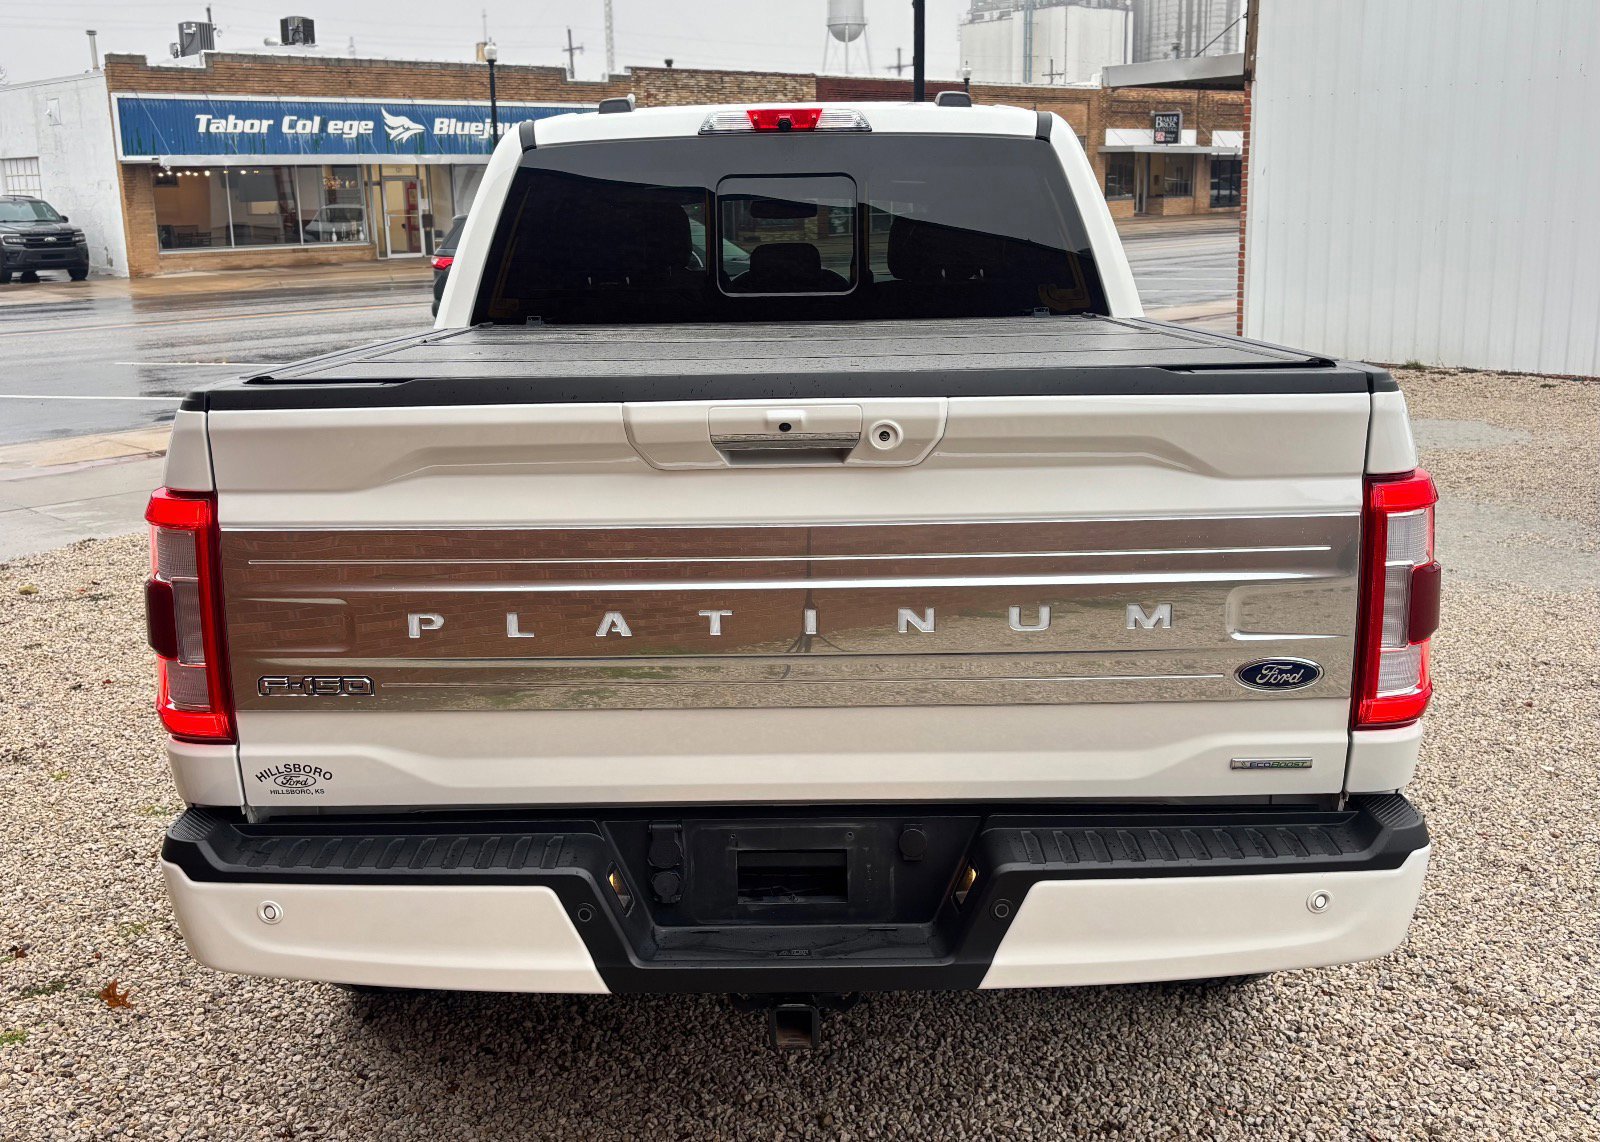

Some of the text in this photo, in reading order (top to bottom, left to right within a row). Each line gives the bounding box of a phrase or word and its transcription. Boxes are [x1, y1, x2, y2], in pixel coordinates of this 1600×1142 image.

[195, 114, 274, 134] Tabor
[407, 602, 1173, 639] PLATINUM
[1255, 664, 1305, 684] Ford
[257, 675, 375, 697] F-150
[255, 763, 333, 783] HILLSBORO
[281, 775, 309, 786] Ford
[269, 788, 313, 796] HILLSBORO,
